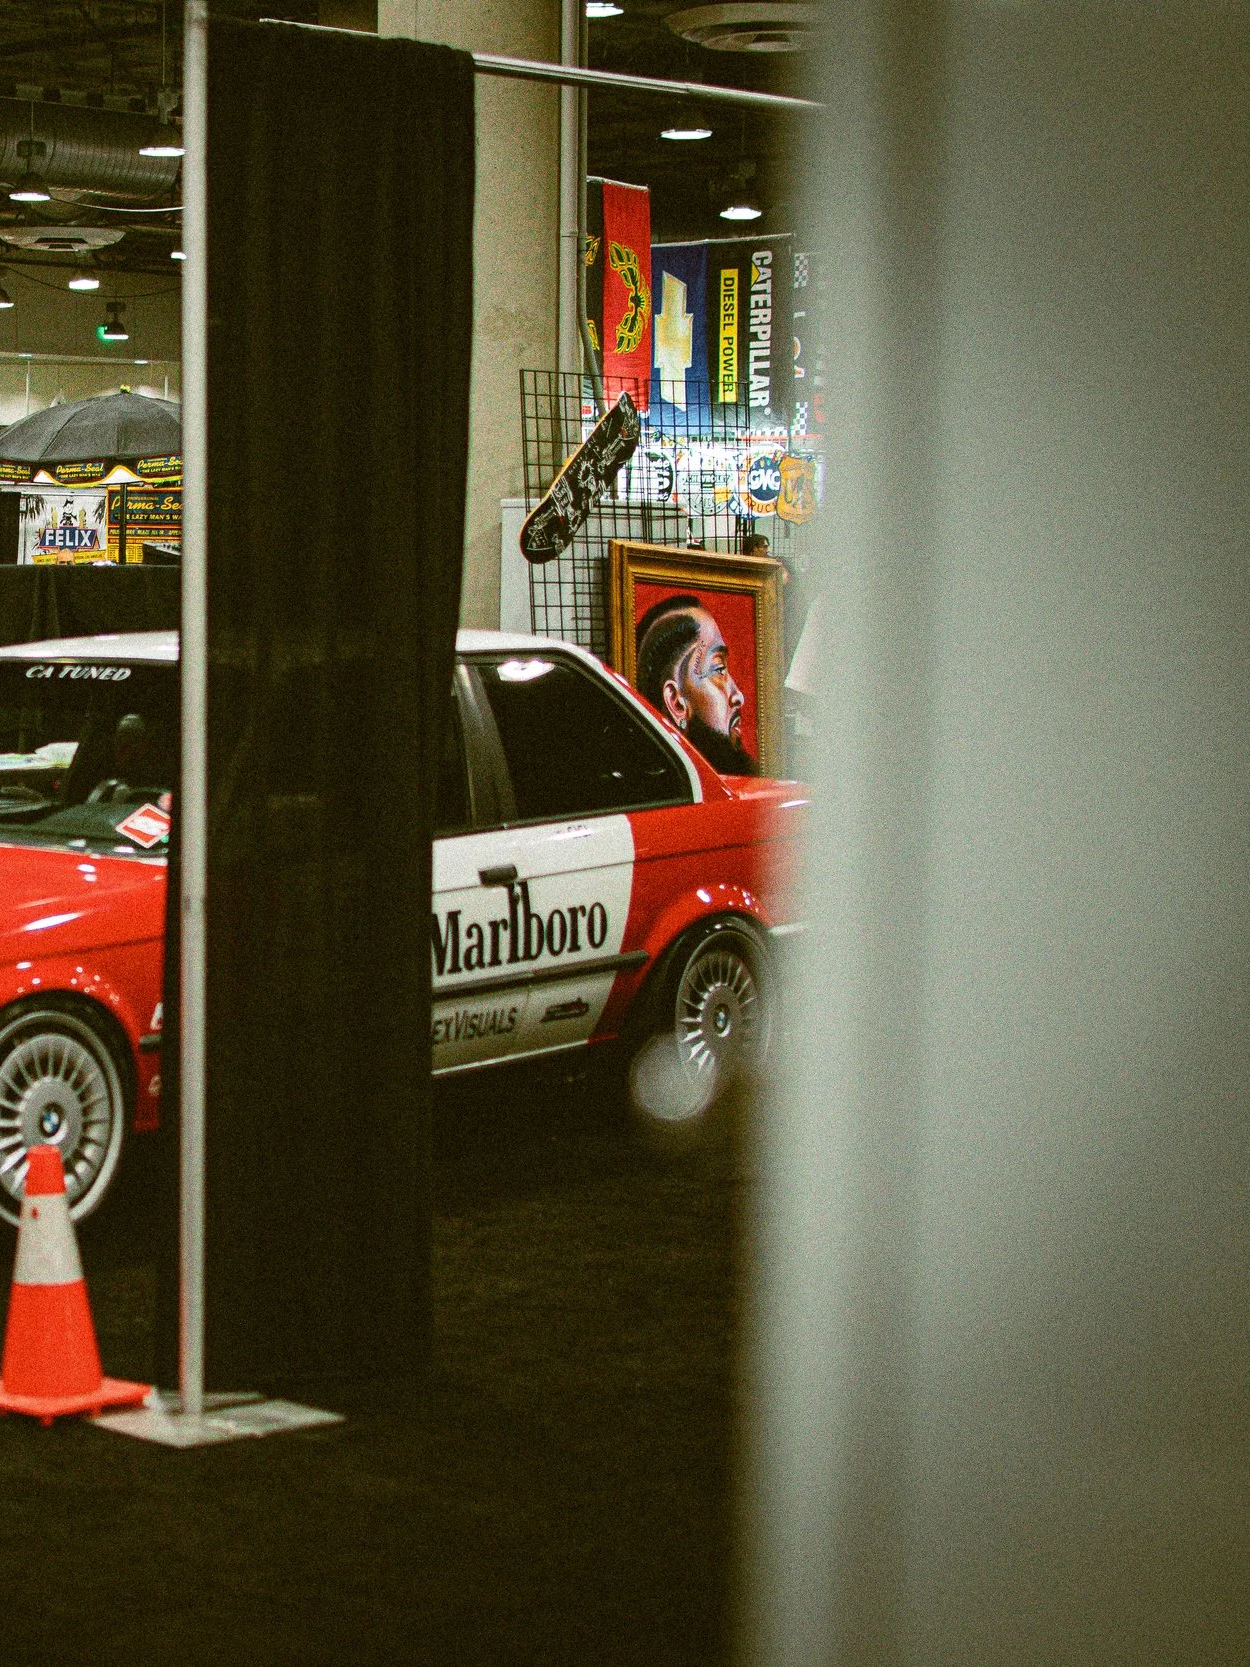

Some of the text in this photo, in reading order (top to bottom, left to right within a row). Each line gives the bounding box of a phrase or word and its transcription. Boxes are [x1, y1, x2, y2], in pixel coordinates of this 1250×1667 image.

[722, 277, 735, 393] DIESEL POWER
[750, 250, 772, 408] CATERPILLAR
[750, 469, 781, 490] GMC
[45, 530, 92, 547] FELIX
[25, 665, 132, 681] CA TUNED
[431, 880, 608, 977] Marlboro
